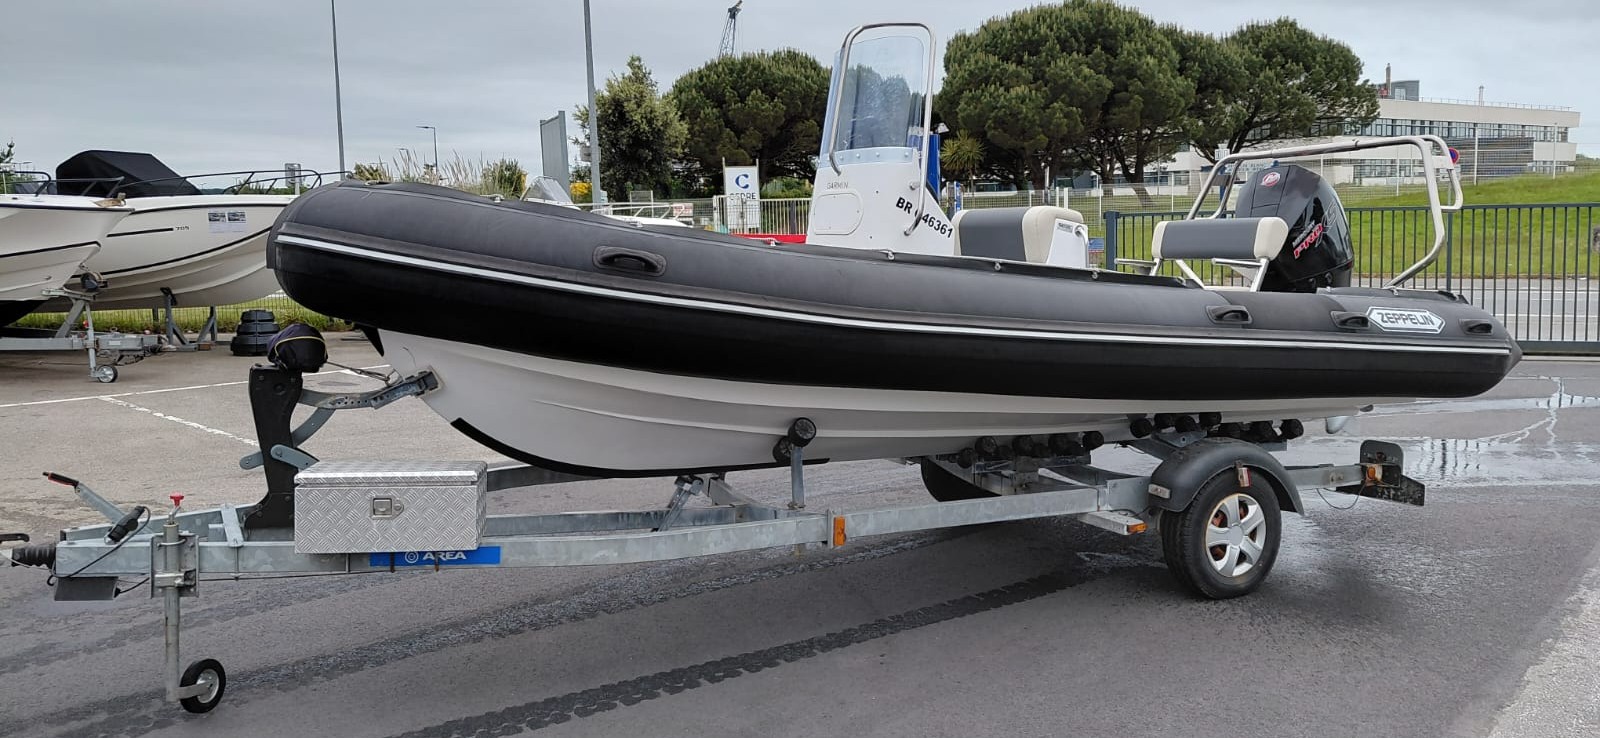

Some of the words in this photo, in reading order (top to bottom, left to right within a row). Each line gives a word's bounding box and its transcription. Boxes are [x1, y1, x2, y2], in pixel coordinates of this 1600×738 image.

[827, 182, 849, 190] GARMIN
[896, 197, 913, 214] BR
[914, 209, 953, 238] 46361
[1377, 312, 1435, 326] ZEPPELIN
[422, 551, 467, 561] AREA
